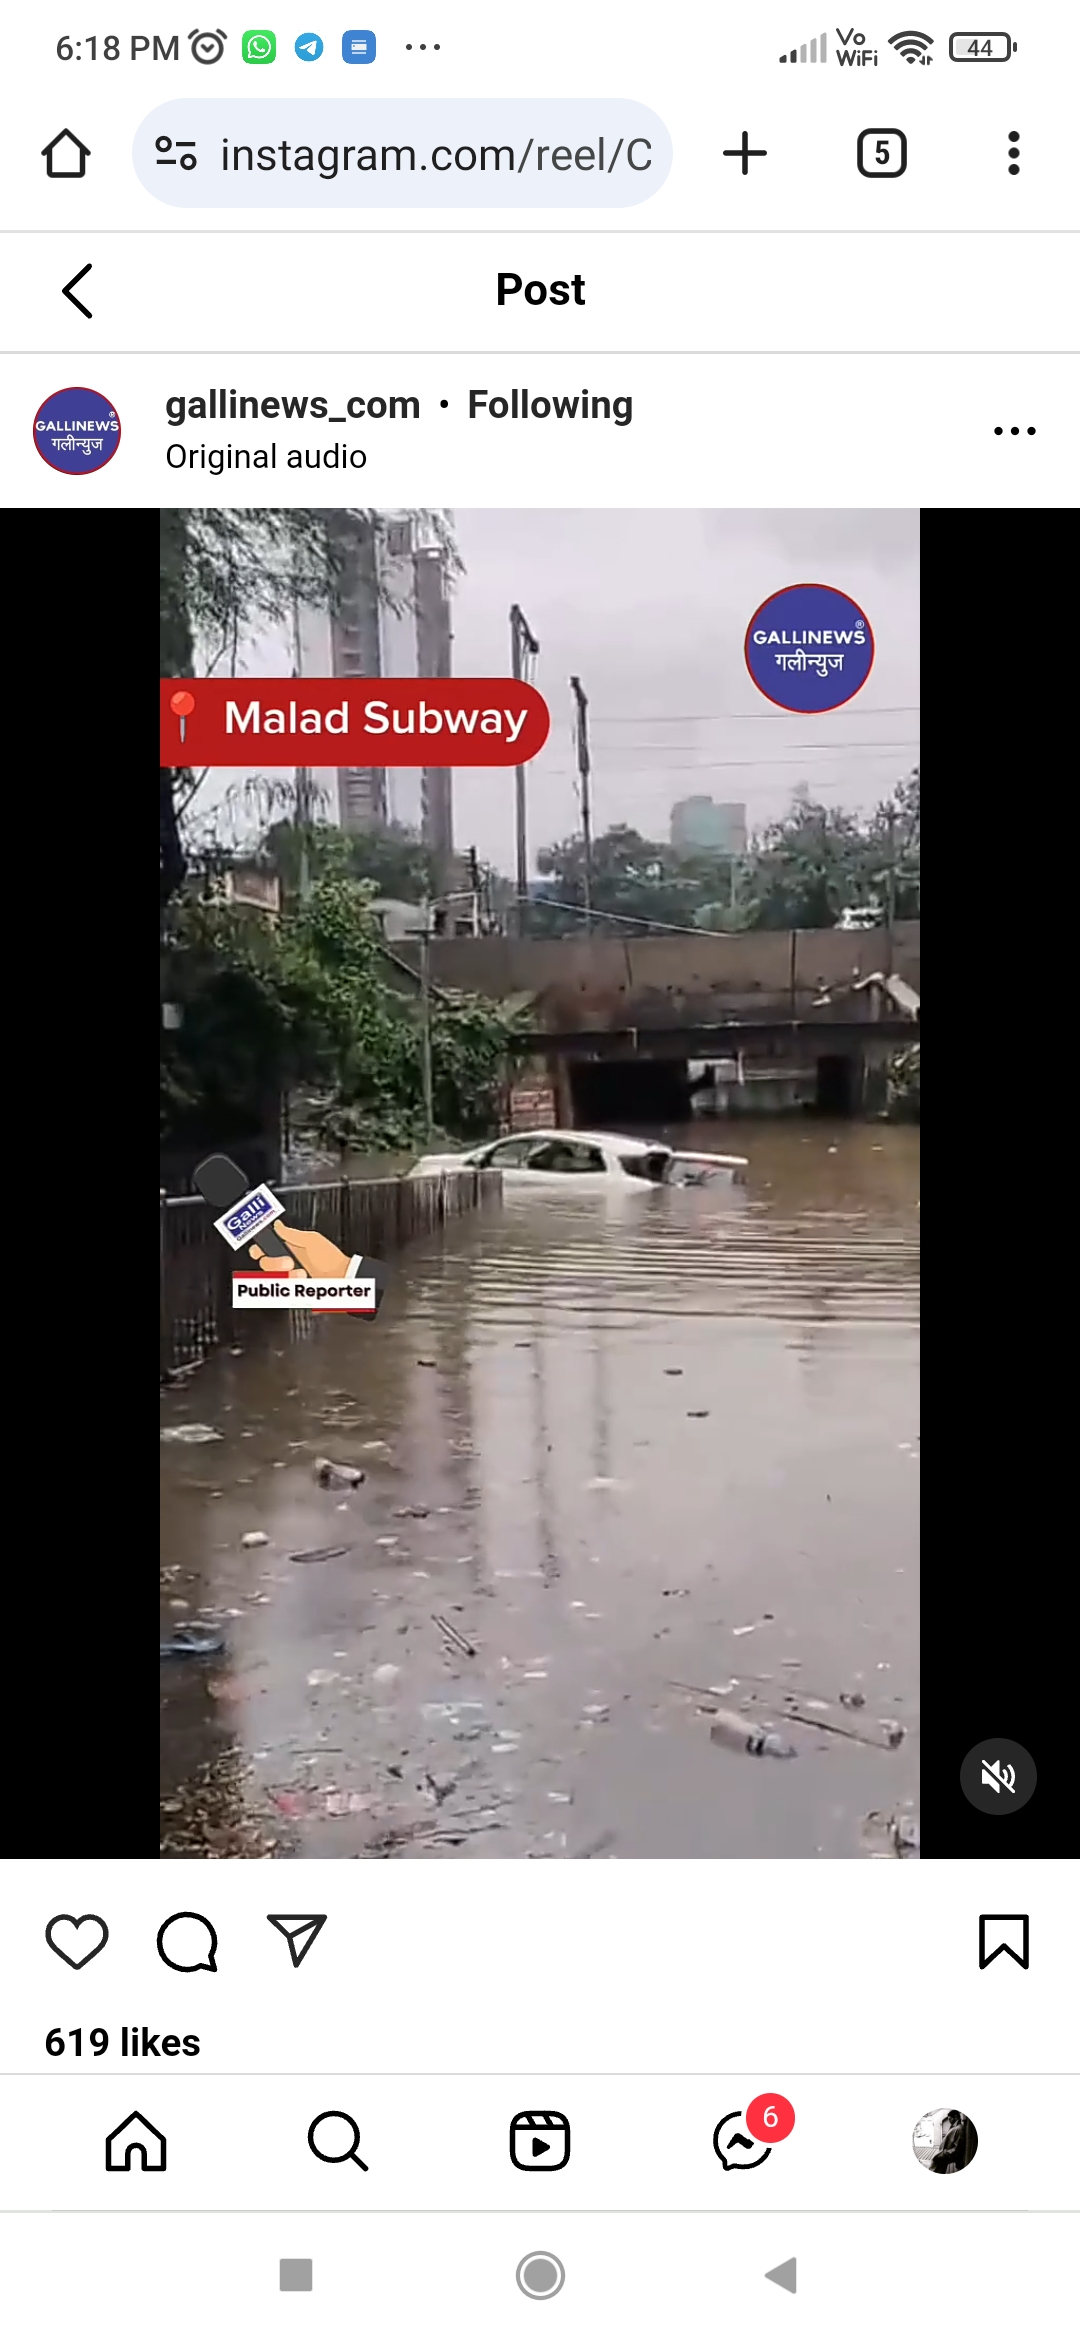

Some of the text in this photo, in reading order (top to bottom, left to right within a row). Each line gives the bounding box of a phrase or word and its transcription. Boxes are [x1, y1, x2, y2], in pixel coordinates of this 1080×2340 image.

[56, 35, 180, 60] 6:18 PM
[836, 28, 866, 45] Vo
[967, 39, 993, 56] 44
[836, 49, 878, 67] WiFi
[221, 136, 653, 180] instagram.com/reel/C
[875, 140, 890, 165] 5
[497, 272, 586, 306] Post
[165, 388, 633, 427] gallinews_com Following
[35, 420, 119, 432] GALLINEWS
[51, 434, 104, 456] गलीन्युज
[166, 442, 367, 476] Original audio
[45, 2026, 201, 2057] 619 likes
[763, 2105, 779, 2128] 6
